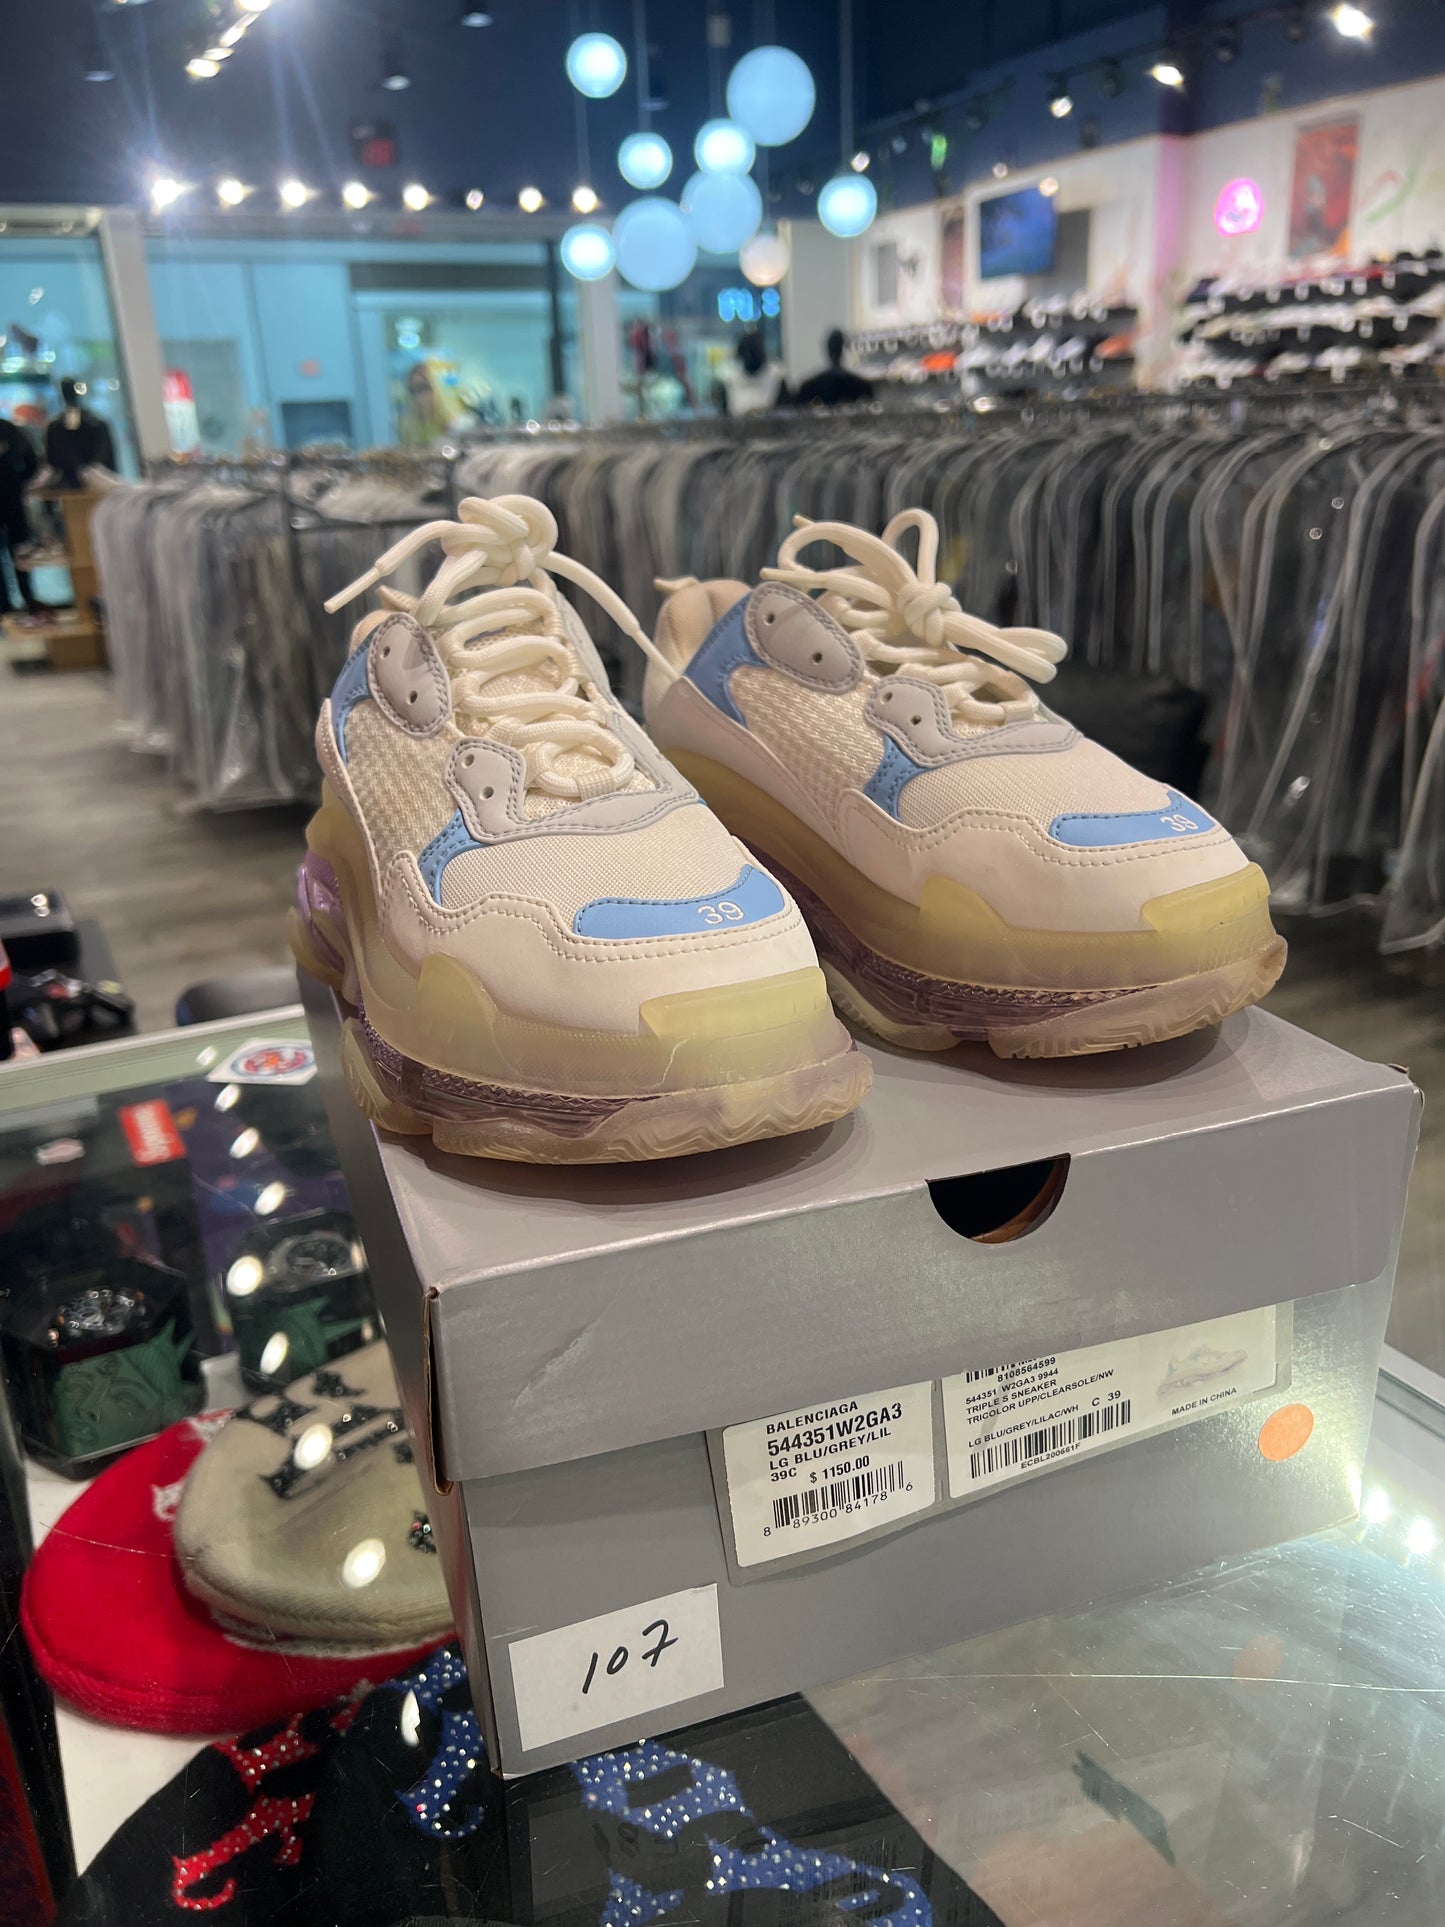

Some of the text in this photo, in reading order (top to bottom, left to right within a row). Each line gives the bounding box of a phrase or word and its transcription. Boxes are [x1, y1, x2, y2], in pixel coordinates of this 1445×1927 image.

[1160, 814, 1198, 832] 39
[697, 901, 744, 925] 39
[966, 1368, 1059, 1404] 544351 W2GA3 9944
[998, 1357, 1056, 1382] 8108564599
[967, 1397, 1000, 1414] TRIPLE
[1011, 1379, 1057, 1400] SNEAKER
[967, 1369, 1114, 1425] TRICOLOR UPP/CLEARSOLE/NW
[1091, 1390, 1121, 1407] C 39
[1172, 1401, 1197, 1415] MADE
[1210, 1388, 1237, 1401] CHINA
[766, 1401, 858, 1435] BALENCIAGA
[767, 1402, 902, 1456] 544351W2GA3
[969, 1404, 1079, 1447] LG BLU/GREY/LILAC/WH
[770, 1427, 891, 1470] LG BLU/GREY/LIL
[771, 1467, 797, 1482] 39C
[822, 1455, 870, 1479] 1150.00
[763, 1482, 913, 1536] 8 89300 84178 6
[582, 1619, 678, 1694] 107
